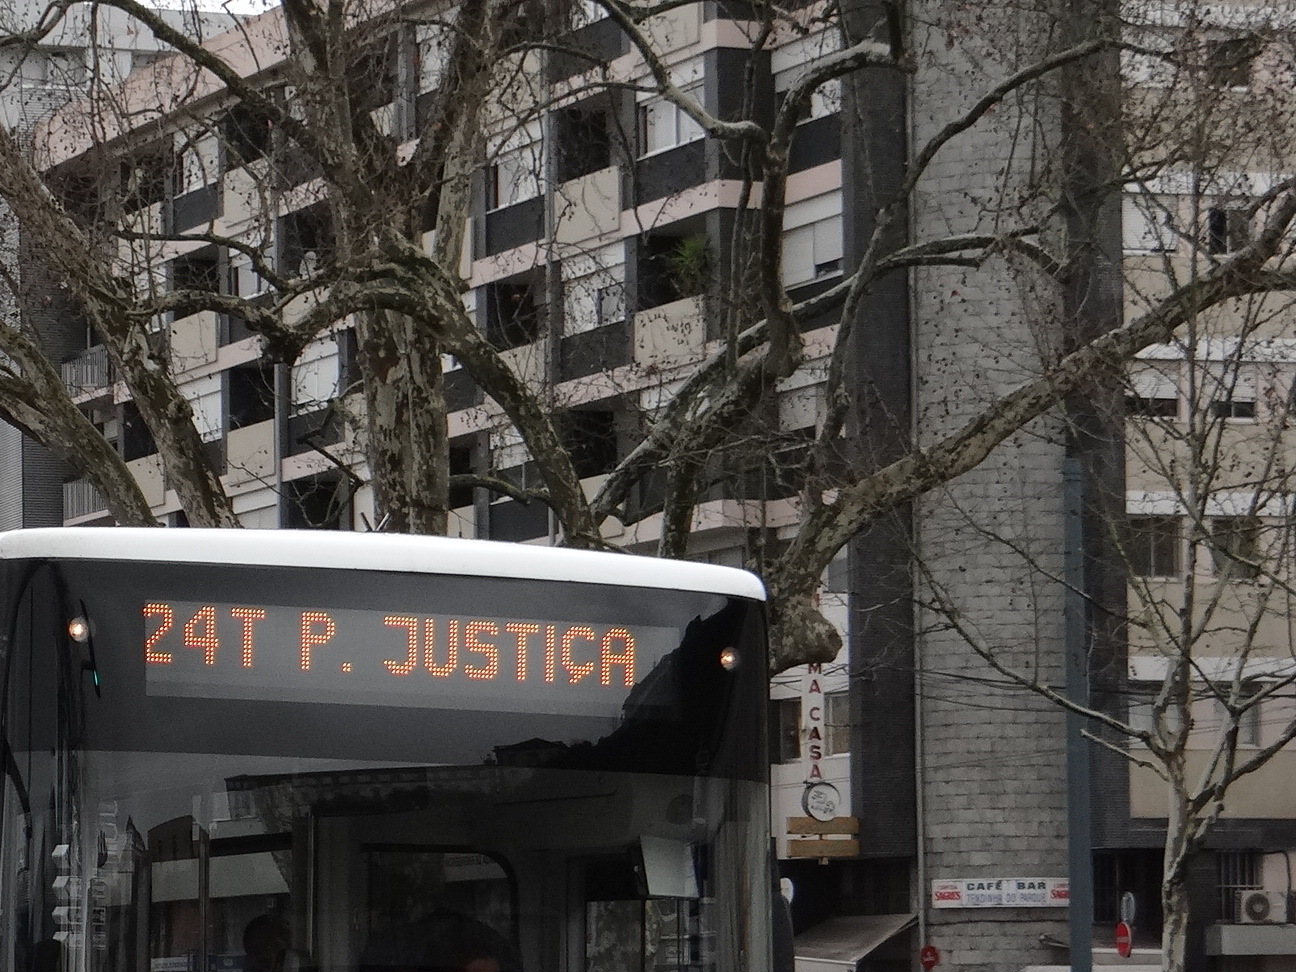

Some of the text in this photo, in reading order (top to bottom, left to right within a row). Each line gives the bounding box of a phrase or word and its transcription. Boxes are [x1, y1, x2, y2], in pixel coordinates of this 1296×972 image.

[142, 602, 265, 668] 24T
[300, 611, 352, 672] P.
[809, 707, 822, 779] CASA
[966, 880, 1003, 891] CAFÉ
[1017, 881, 1047, 890] BAR
